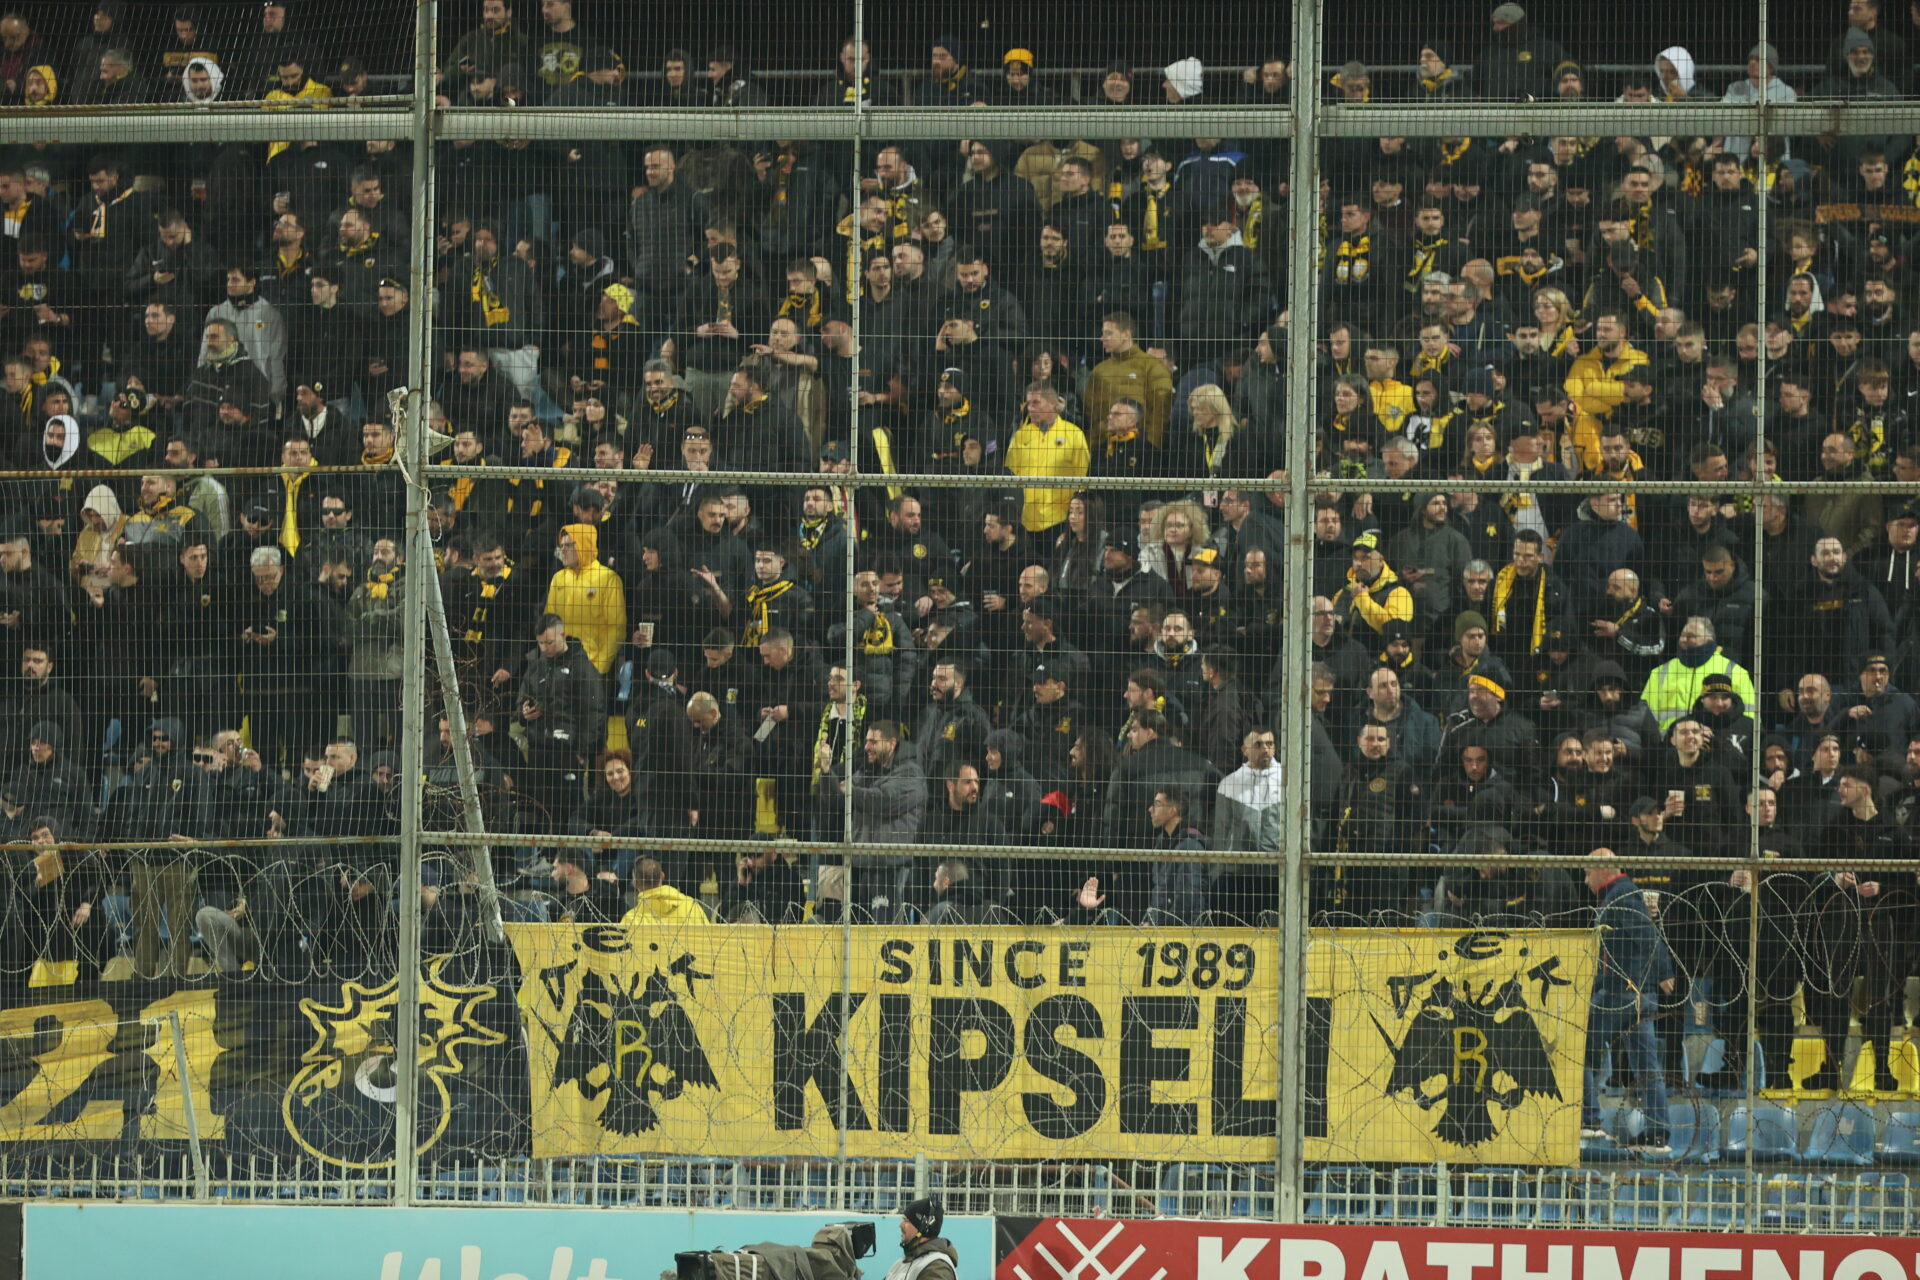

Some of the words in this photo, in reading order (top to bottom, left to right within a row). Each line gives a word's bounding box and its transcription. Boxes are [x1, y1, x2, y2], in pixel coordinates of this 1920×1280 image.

[879, 938, 1091, 989] SINCE
[1135, 941, 1256, 991] 1989
[615, 1019, 653, 1088] R
[772, 991, 1333, 1140] KIPSELI
[1452, 1026, 1489, 1093] R
